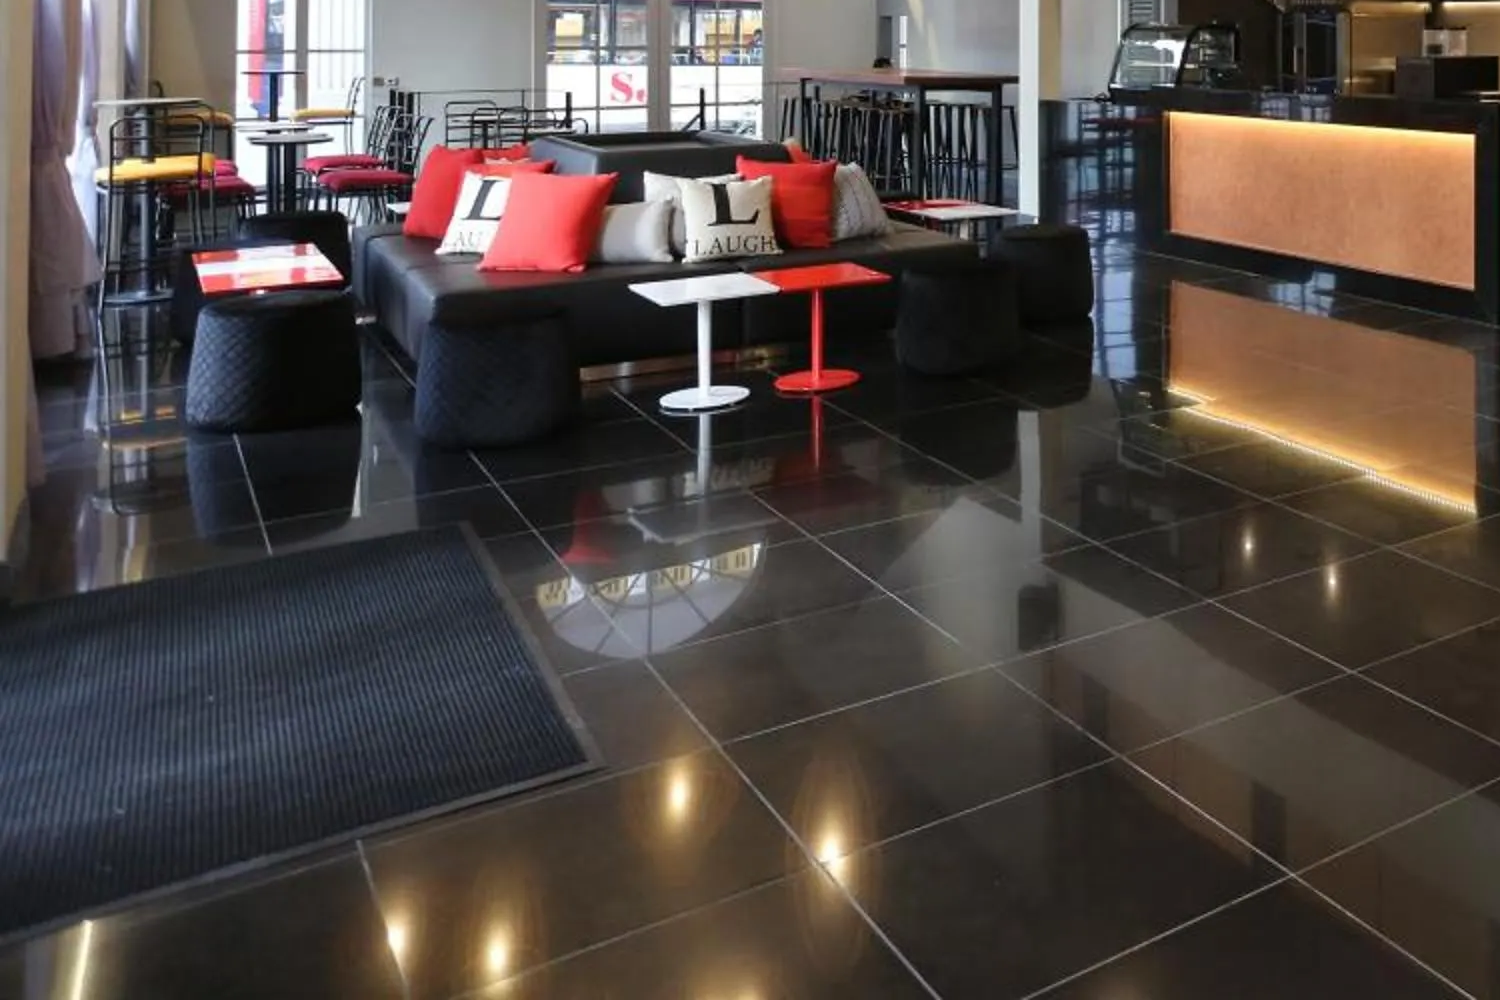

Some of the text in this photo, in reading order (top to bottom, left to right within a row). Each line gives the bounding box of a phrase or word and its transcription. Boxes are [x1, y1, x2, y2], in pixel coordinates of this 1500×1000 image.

[460, 179, 503, 221] L
[704, 182, 760, 227] L
[694, 235, 776, 257] LAUGH
